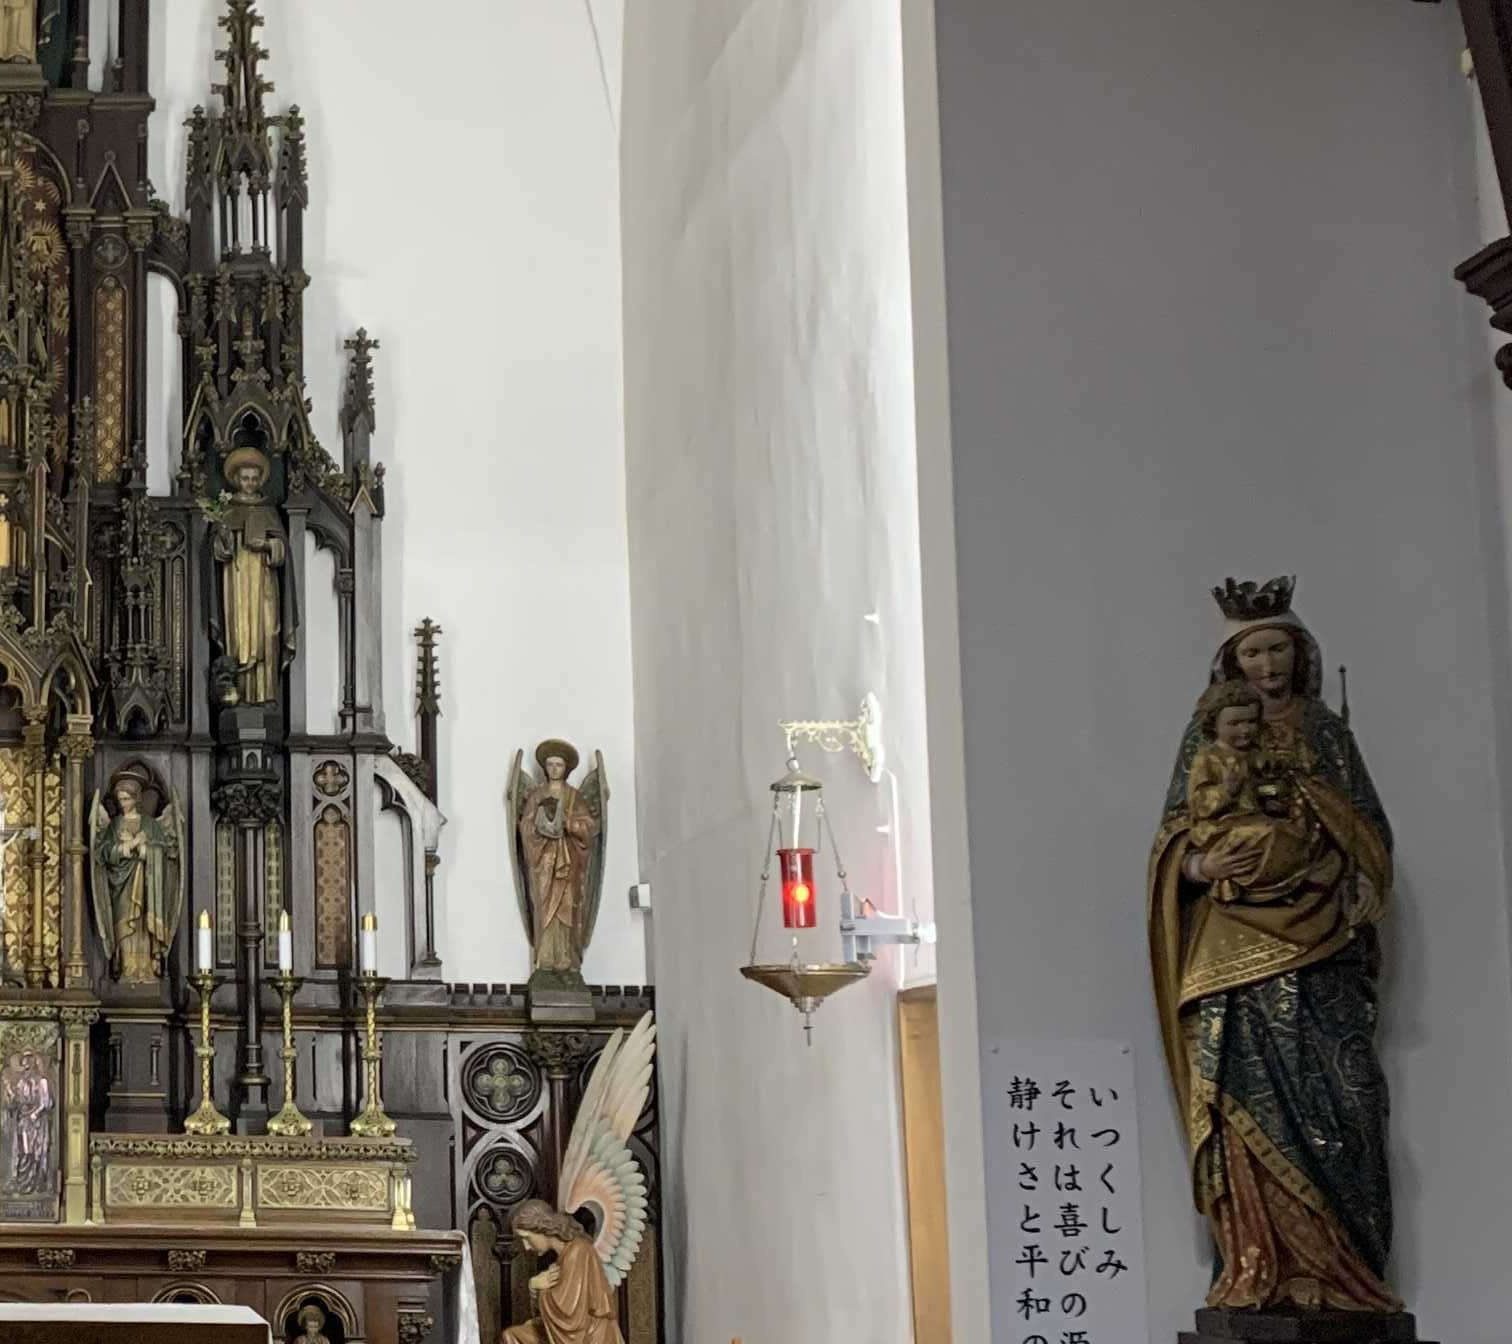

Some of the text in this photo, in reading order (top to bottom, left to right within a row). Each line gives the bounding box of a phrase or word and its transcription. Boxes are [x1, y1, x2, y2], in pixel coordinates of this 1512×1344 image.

[1088, 1085, 1129, 1280] いつくしみ
